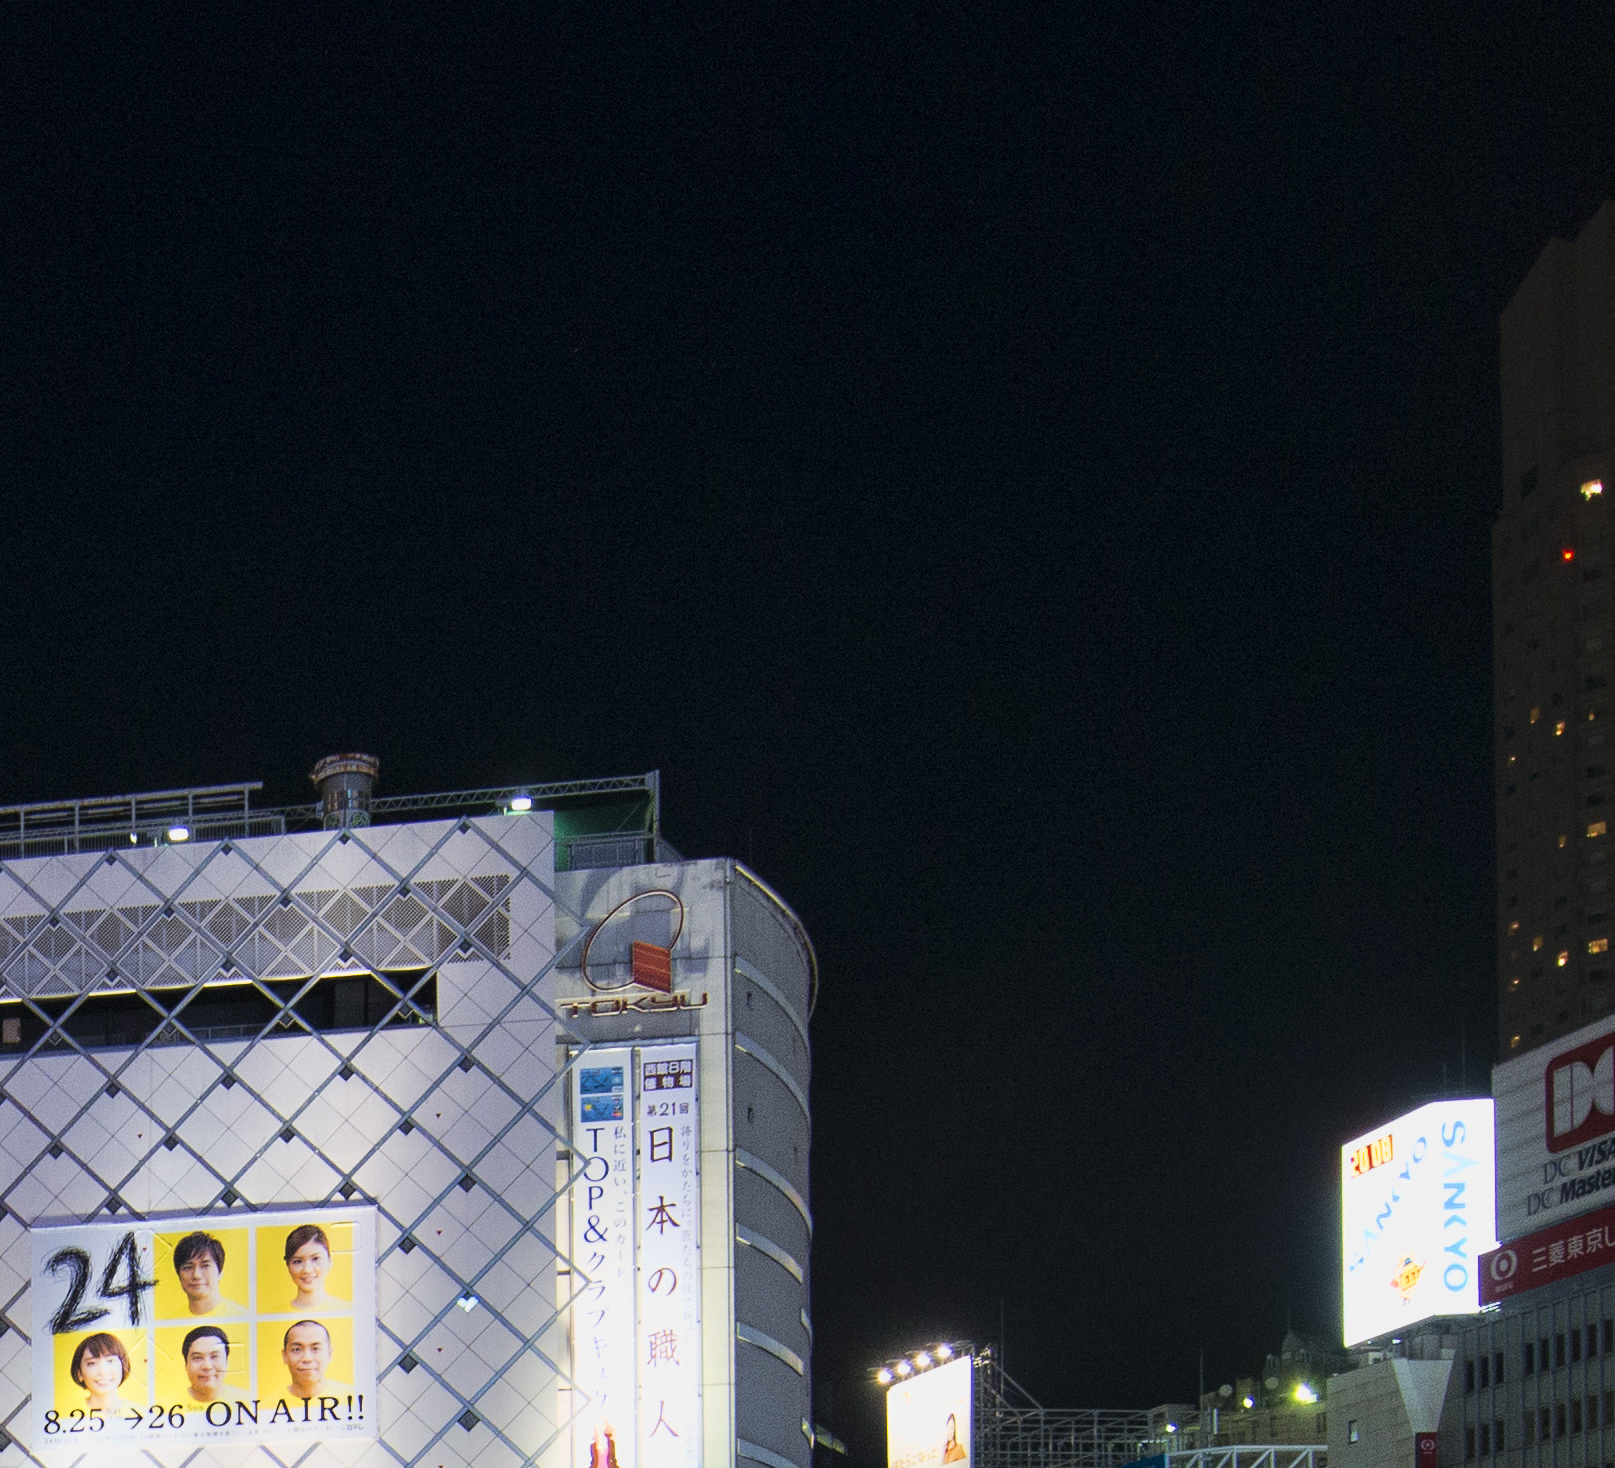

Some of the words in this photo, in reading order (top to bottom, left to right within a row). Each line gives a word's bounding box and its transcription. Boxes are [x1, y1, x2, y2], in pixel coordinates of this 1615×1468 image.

[560, 992, 709, 1019] TOKYU
[1442, 1120, 1480, 1293] SANKYO
[40, 1230, 161, 1336] 24
[43, 1408, 106, 1435] 8.25
[205, 1399, 261, 1427] ON
[270, 1394, 365, 1424] AIR!!
